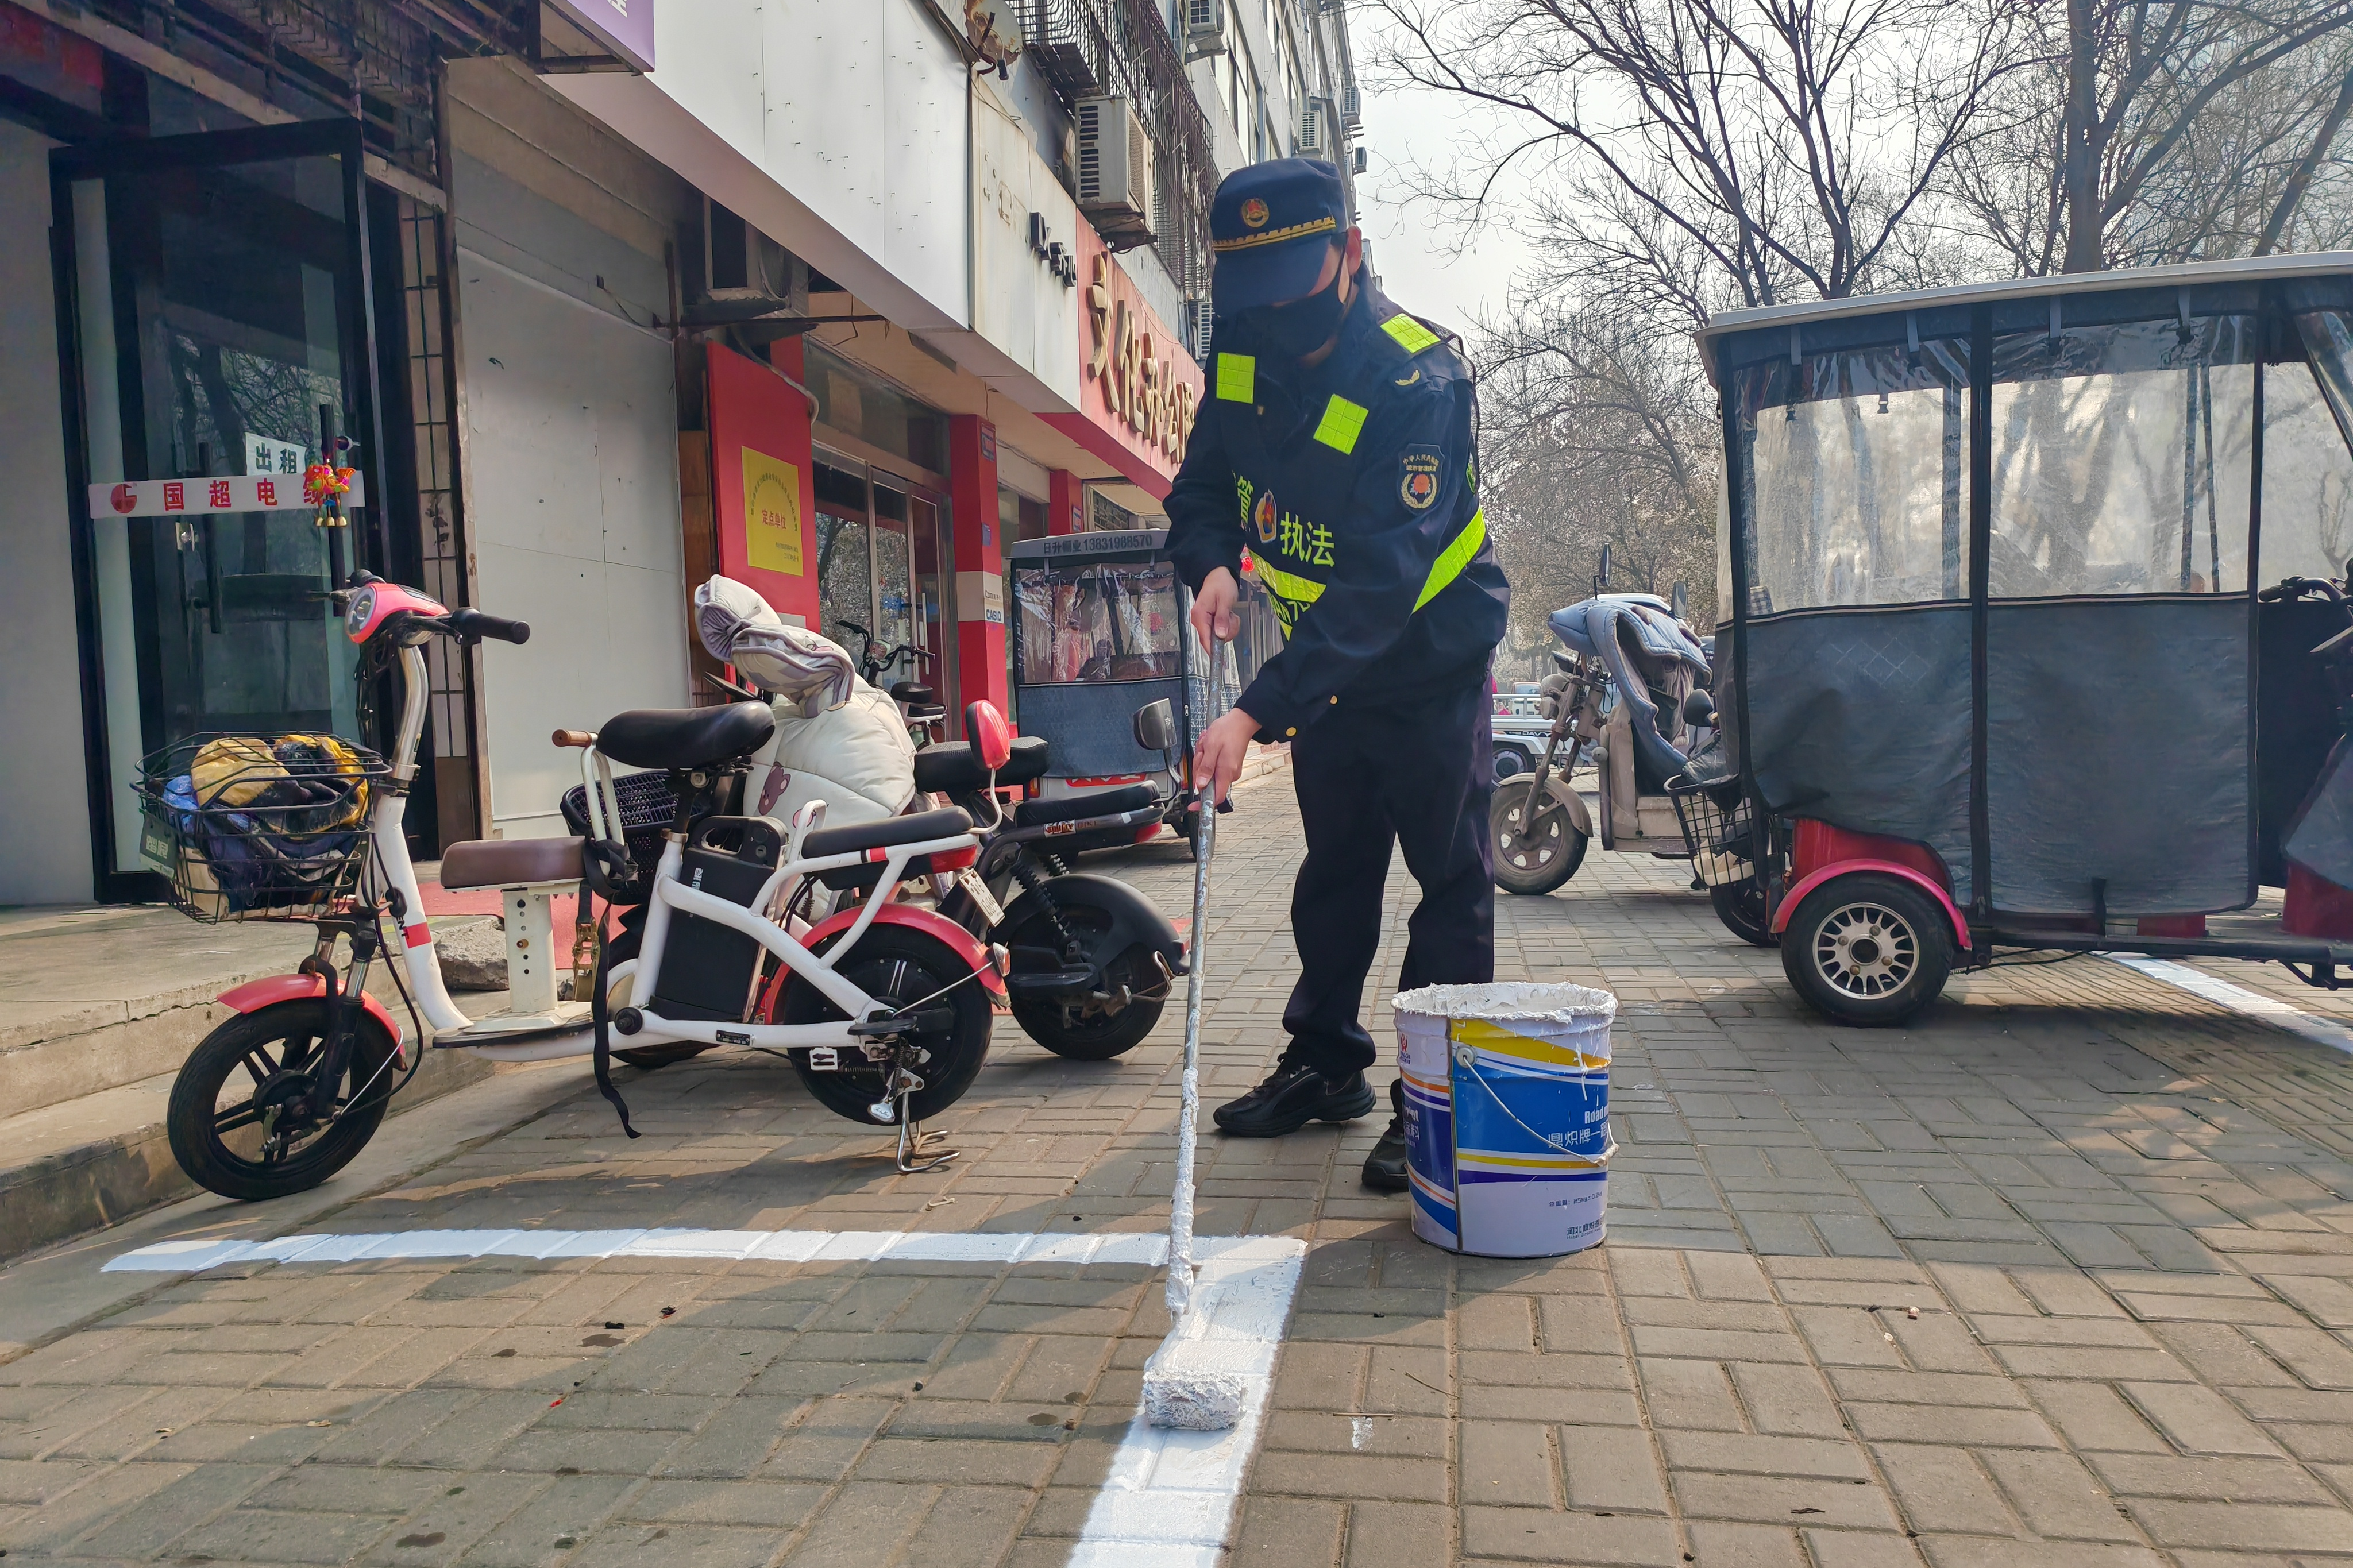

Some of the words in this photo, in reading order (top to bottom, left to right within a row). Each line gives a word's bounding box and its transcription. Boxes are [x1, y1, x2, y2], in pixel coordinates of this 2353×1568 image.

[255, 442, 297, 474] 出租
[762, 508, 786, 530] 定点单位
[1280, 511, 1335, 567] 执法
[986, 609, 1001, 621] CASIO
[1584, 1106, 1604, 1124] Road
